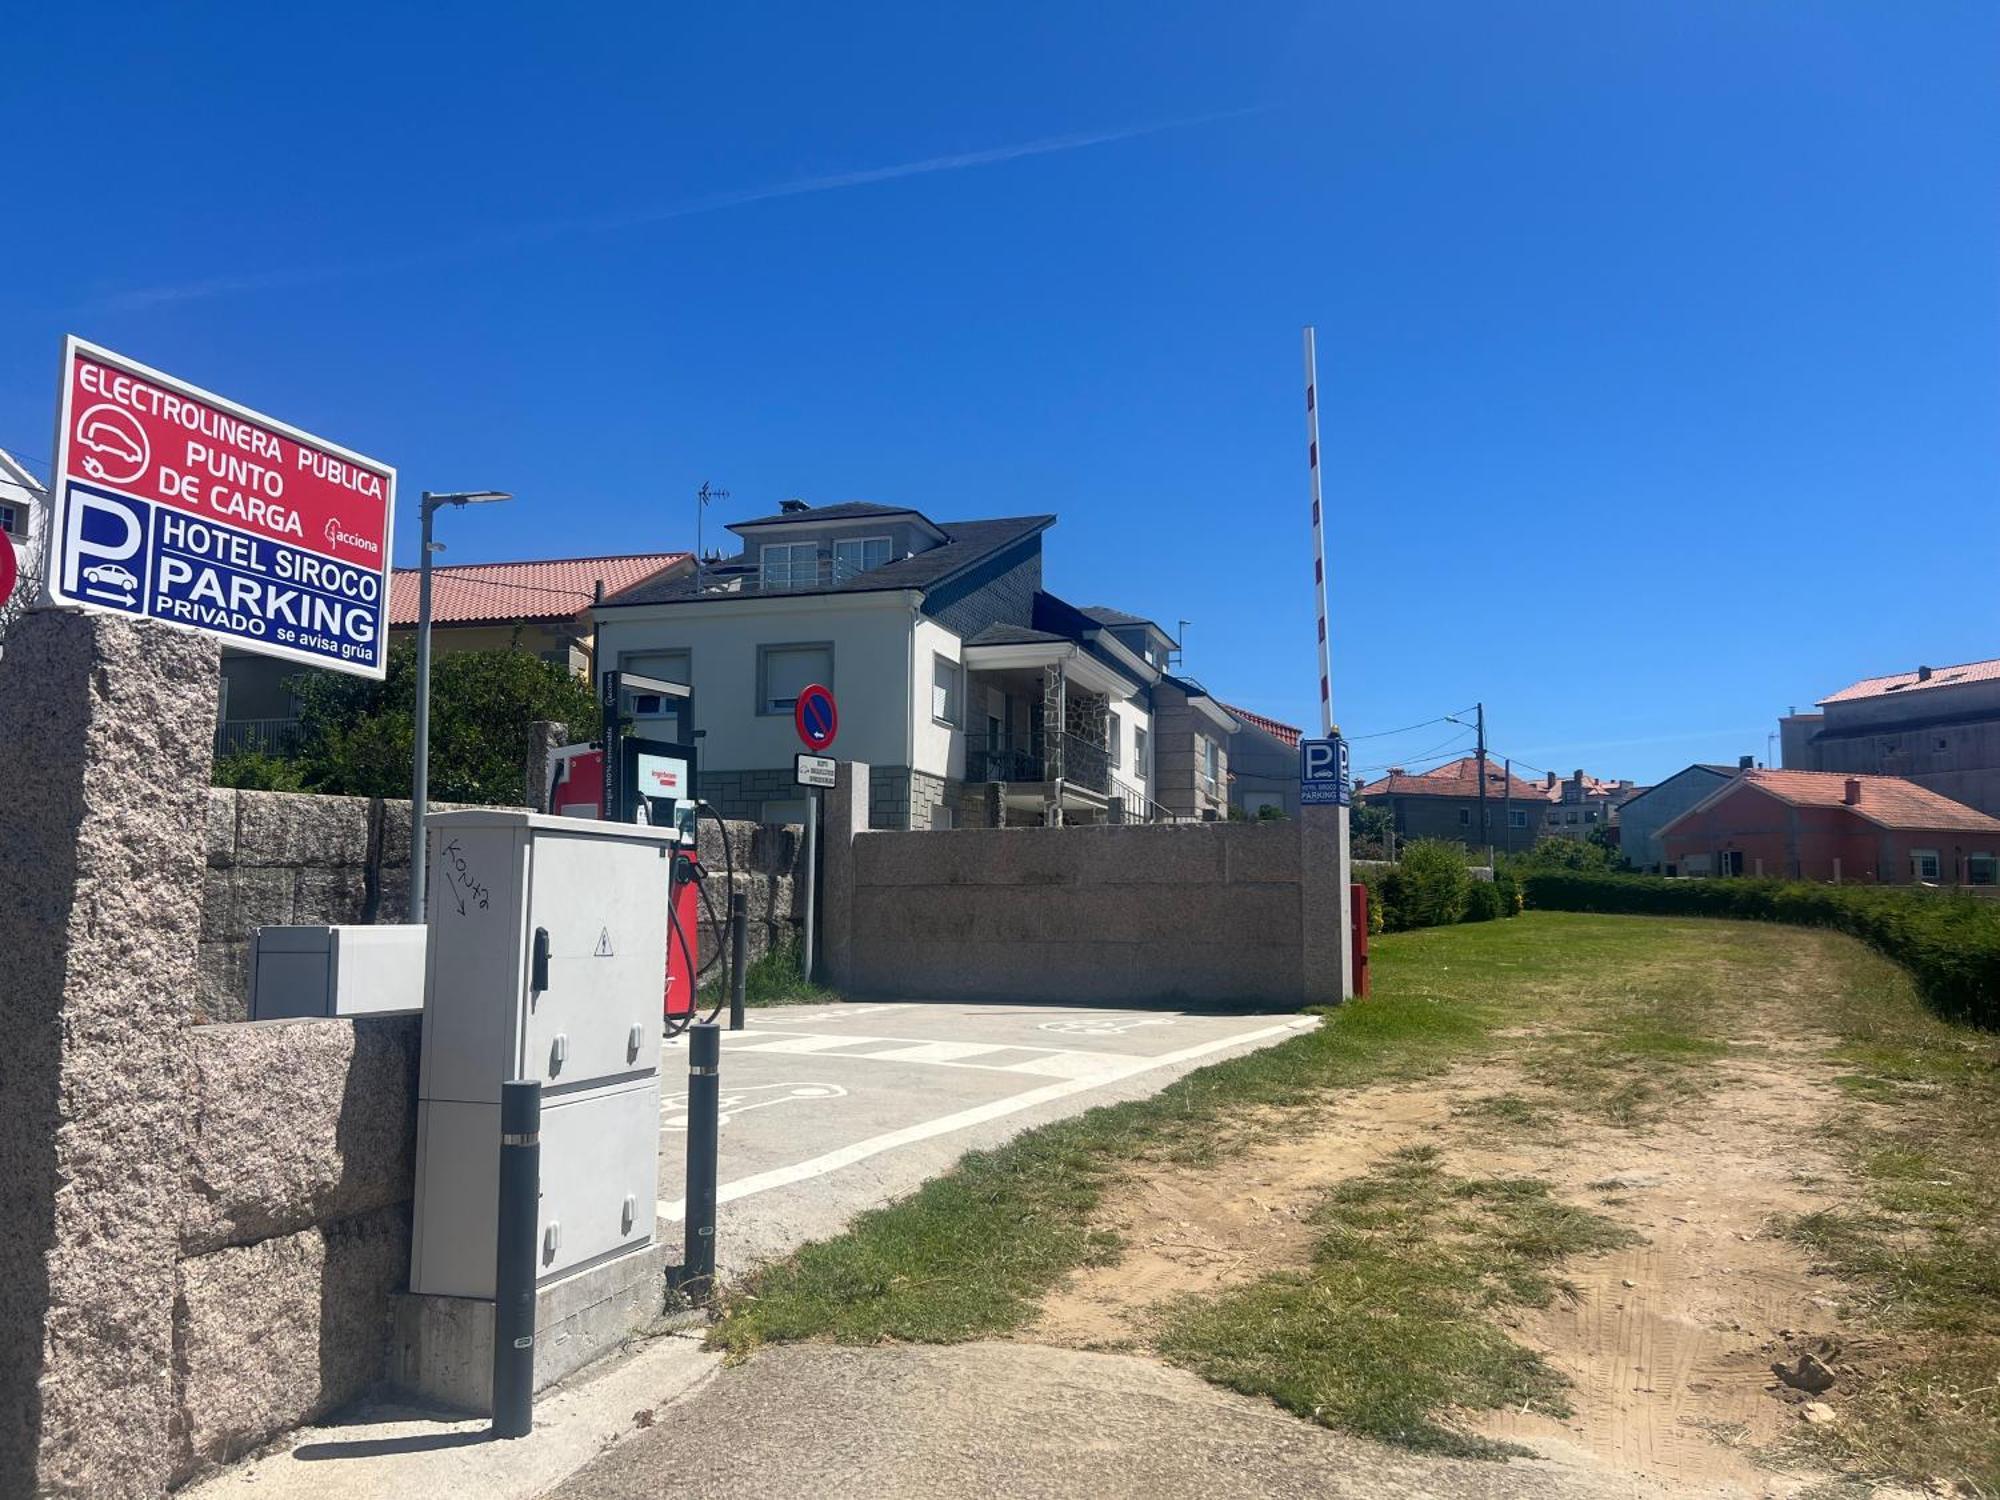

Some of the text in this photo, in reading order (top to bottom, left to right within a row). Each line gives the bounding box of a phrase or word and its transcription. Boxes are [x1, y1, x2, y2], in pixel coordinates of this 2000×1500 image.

[80, 364, 282, 463] ELECTROLINERA
[159, 466, 303, 538] DE CARGA
[186, 441, 283, 498] PUNTO
[63, 489, 142, 593] P
[163, 515, 377, 602] HOTEL SIROCO
[336, 530, 378, 553] acciona
[157, 595, 373, 660] PRIVADO se avisa grúa
[159, 555, 374, 642] PARKING
[1306, 745, 1333, 779] P
